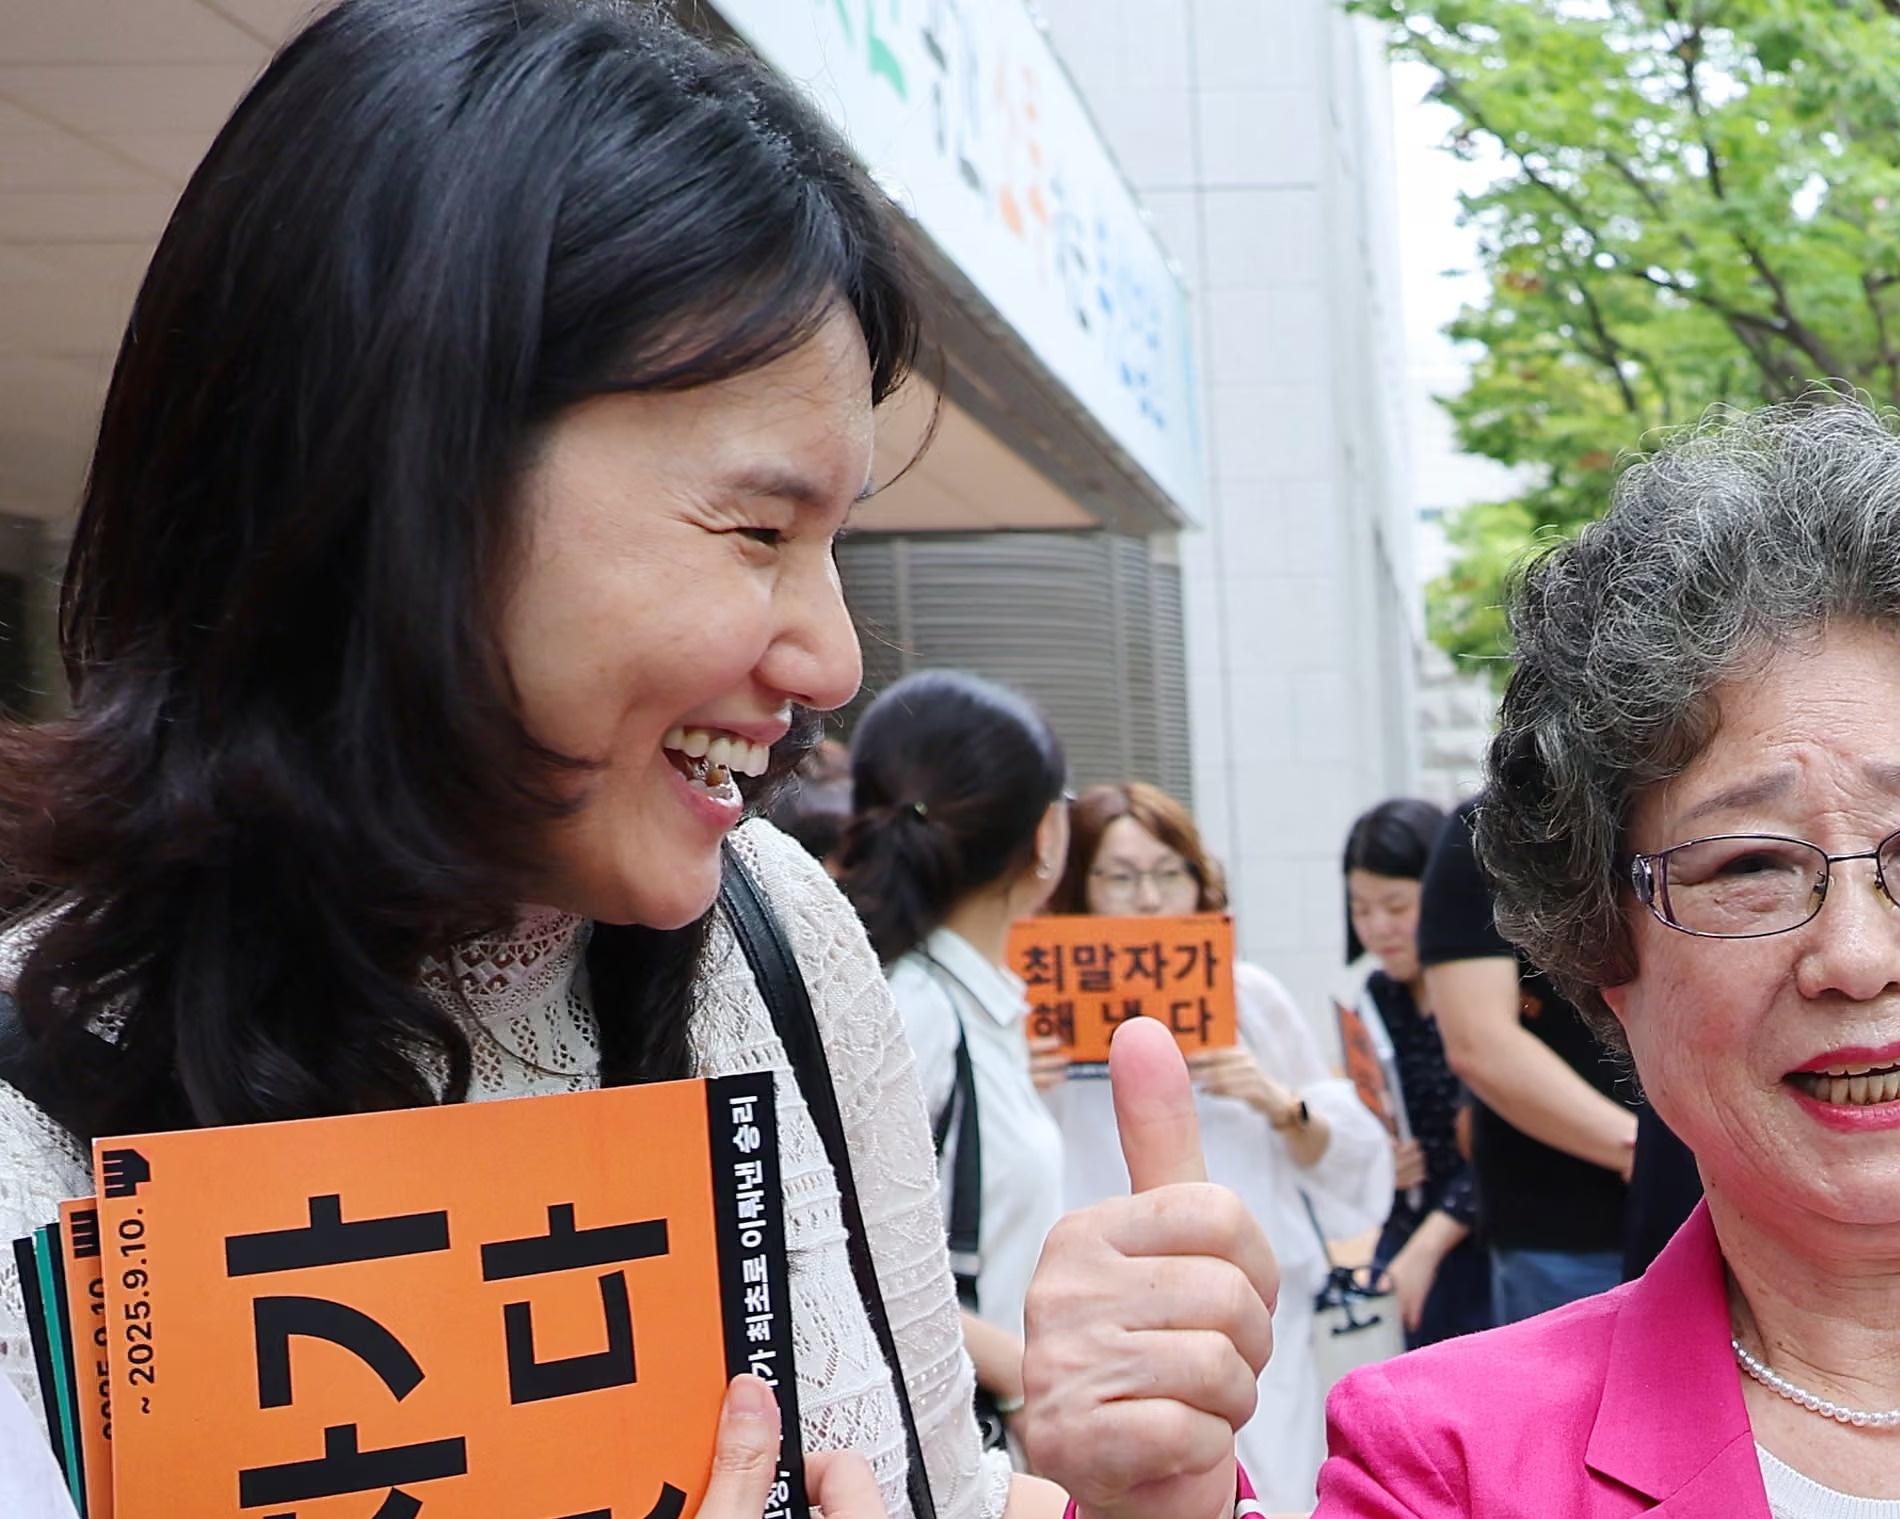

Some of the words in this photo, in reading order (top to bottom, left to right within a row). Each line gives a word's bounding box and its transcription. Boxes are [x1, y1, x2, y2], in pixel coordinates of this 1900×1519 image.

[1023, 940, 1218, 991] 최말자가
[729, 1096, 761, 1153] 승리
[733, 1160, 767, 1248] 이뤄낸
[118, 1207, 155, 1386] 2025.9.10.
[742, 1254, 774, 1342] 최초로
